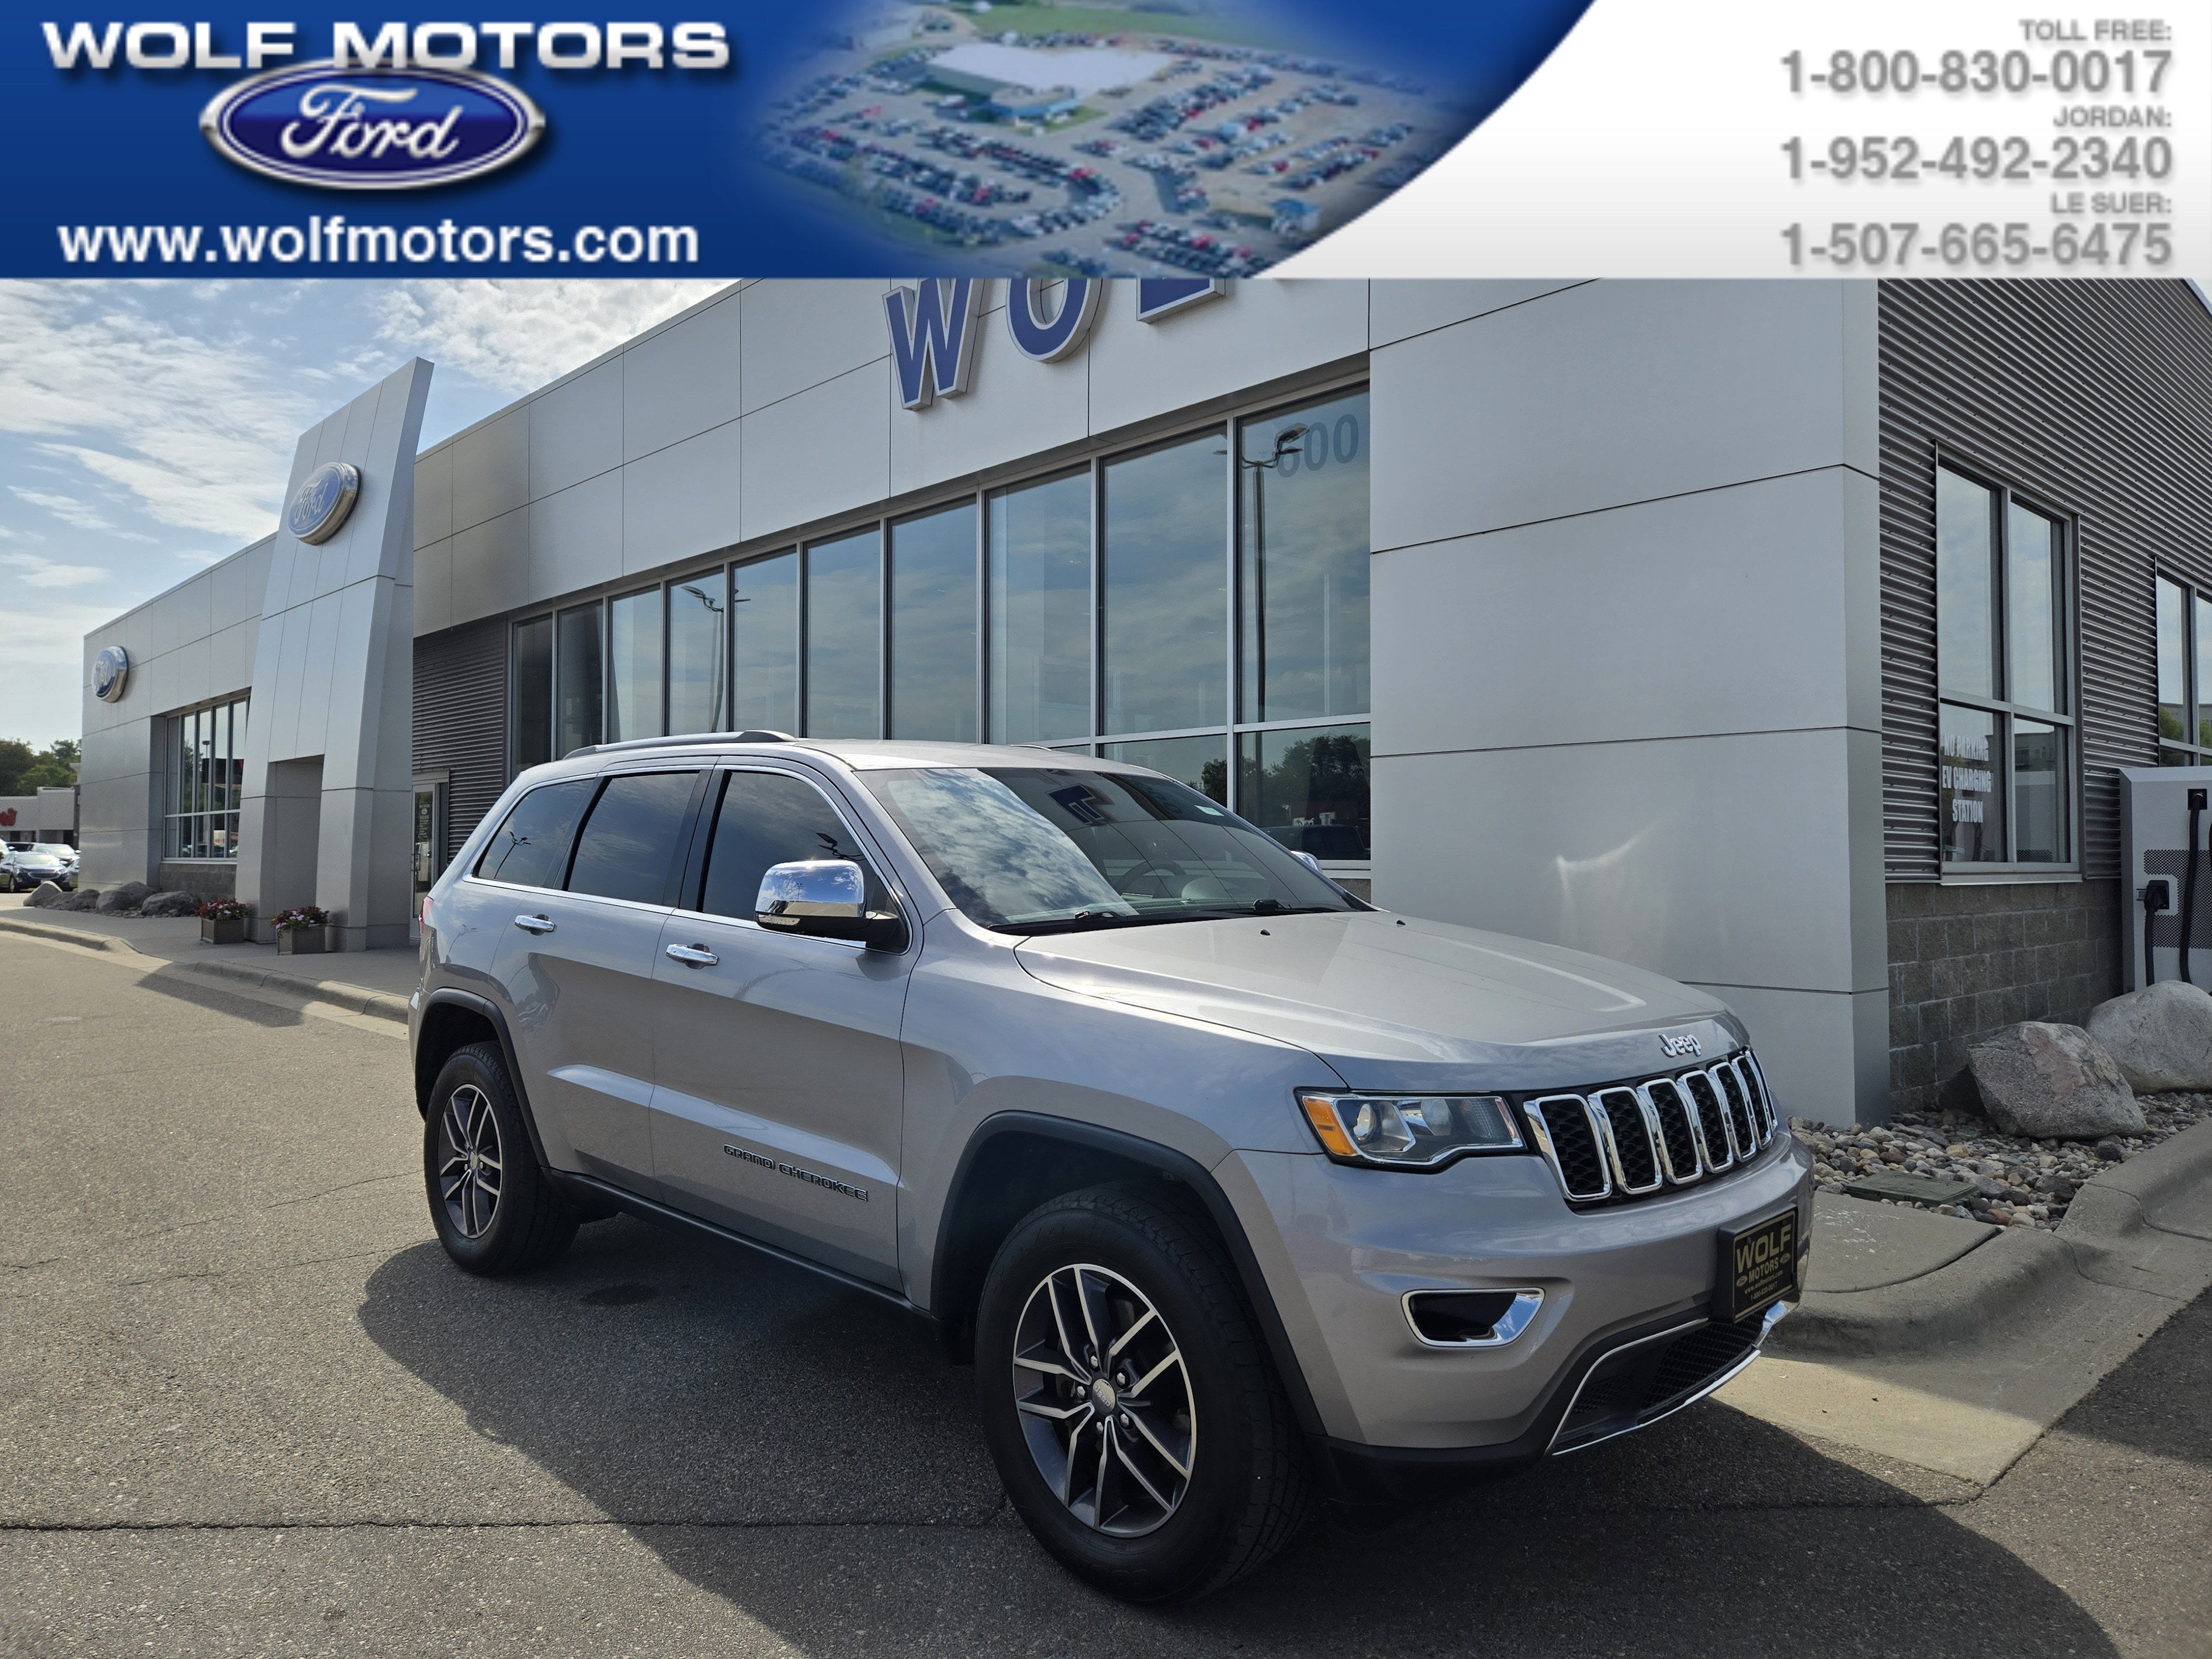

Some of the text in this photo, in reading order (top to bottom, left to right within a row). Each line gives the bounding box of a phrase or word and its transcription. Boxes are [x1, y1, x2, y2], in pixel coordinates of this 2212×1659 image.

[294, 479, 328, 525] Ford
[1944, 733, 1989, 762] NO PARKING
[1942, 765, 1991, 793] EV CHARGING
[1952, 798, 1984, 823] STATION
[1659, 1034, 1702, 1057] Jeep
[723, 1144, 868, 1202] GRAND CHEROKEE
[1736, 1223, 1792, 1274] WOLF
[1749, 1256, 1780, 1284] MOTORS
[1094, 1385, 1111, 1407] Jeep
